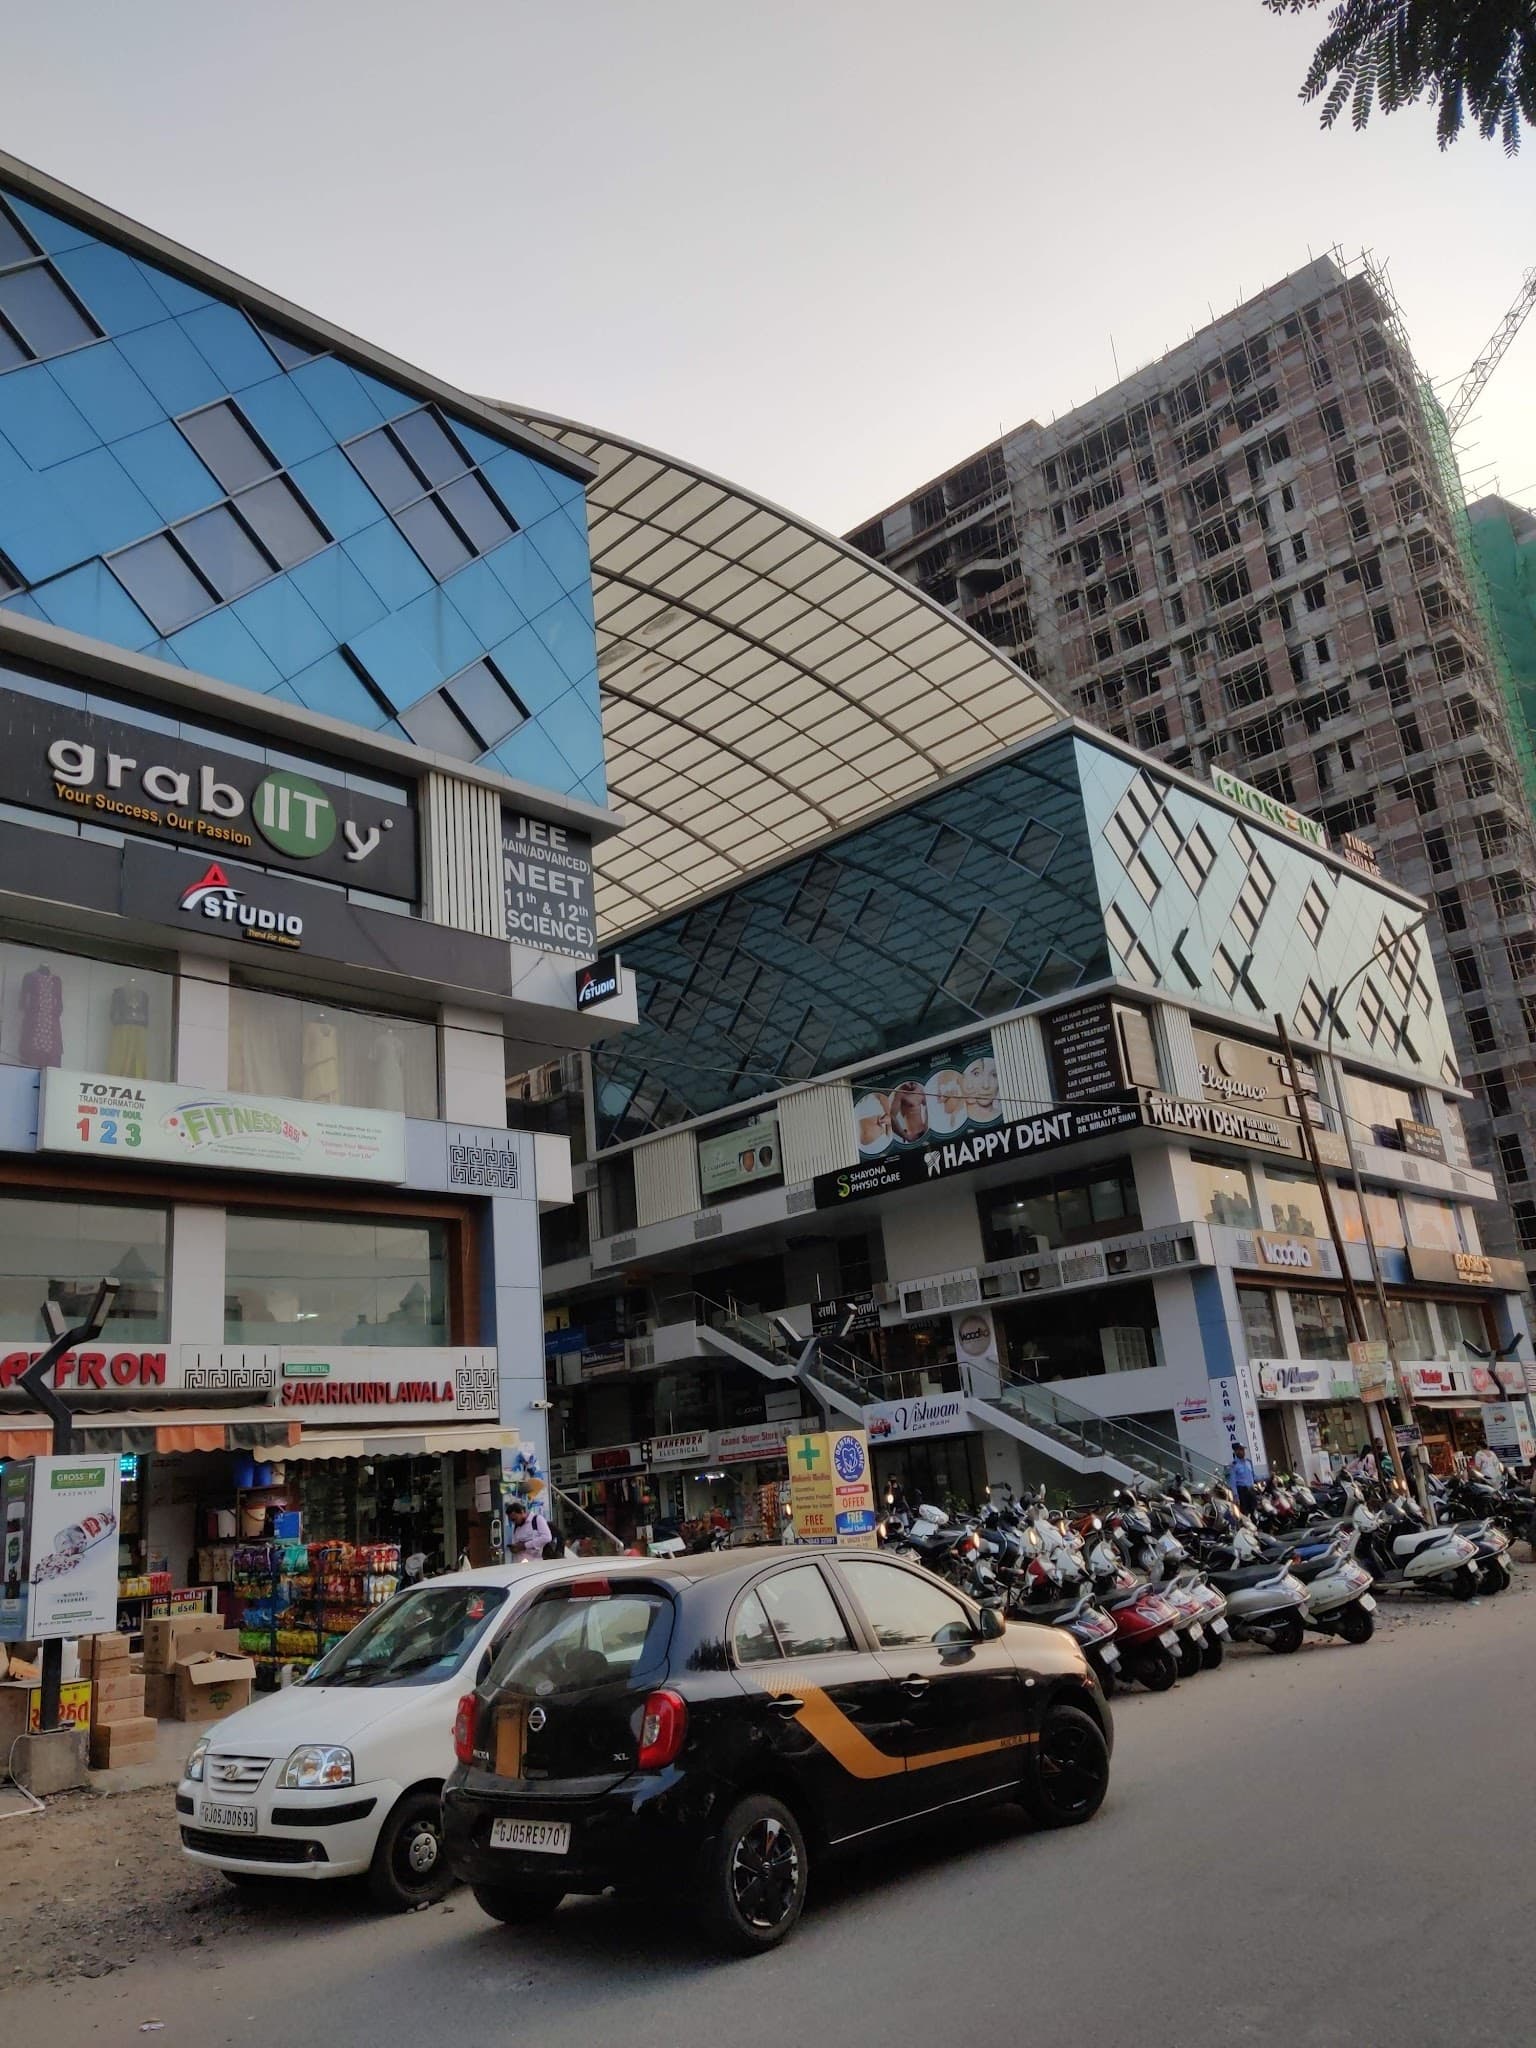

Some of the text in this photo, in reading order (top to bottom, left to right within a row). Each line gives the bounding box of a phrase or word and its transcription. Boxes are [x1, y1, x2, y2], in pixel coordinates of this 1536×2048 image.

[55, 782, 252, 847] Your Success, Our Passion
[515, 817, 569, 852] JEE
[1345, 832, 1376, 861] TIMES
[1344, 849, 1382, 879] SQUARE
[504, 858, 585, 900] NEET
[204, 893, 303, 936] STUDIO
[542, 902, 553, 915] &
[558, 902, 589, 922] 12th
[584, 978, 616, 1000] STUDIO
[1080, 1023, 1111, 1037] TREATMENT
[1077, 1048, 1108, 1062] TREATMENT
[1094, 1060, 1108, 1069] PEEL
[79, 1082, 147, 1102] TOTAL
[1085, 1081, 1116, 1095] TREATMENT
[1199, 1063, 1267, 1101] Elegance
[79, 1095, 145, 1110] TRANSFORMATION
[1075, 1106, 1121, 1124] DENTAL CARE
[1077, 1125, 1089, 1135] DR.
[1089, 1119, 1111, 1132] NIRALI
[1118, 1112, 1137, 1125] SHAH
[1161, 1098, 1248, 1139] HAPPY DENT
[76, 1118, 142, 1147] 1 2 3
[182, 1106, 282, 1146] FITNESS
[942, 1112, 1072, 1169] HAPPY DENT
[850, 1165, 887, 1182] SHAYONA
[851, 1171, 901, 1192] PHYSIO CARE
[281, 1382, 454, 1407] SAVARKUNDLAWALA
[1220, 1380, 1231, 1408] CAR
[1241, 1368, 1250, 1400] CAR
[894, 1401, 960, 1431] Vishwam
[912, 1422, 927, 1432] CAR
[656, 1435, 703, 1450] MAHENDRA
[741, 1433, 761, 1444] Super
[659, 1446, 699, 1458] ELECTRICAL
[843, 1497, 865, 1508] OFFER
[805, 1514, 825, 1526] FREE
[846, 1511, 864, 1523] FREE
[613, 1753, 630, 1761] XL
[204, 1807, 254, 1828] GJ05JD0693
[500, 1823, 567, 1847] GJ05RE9701
